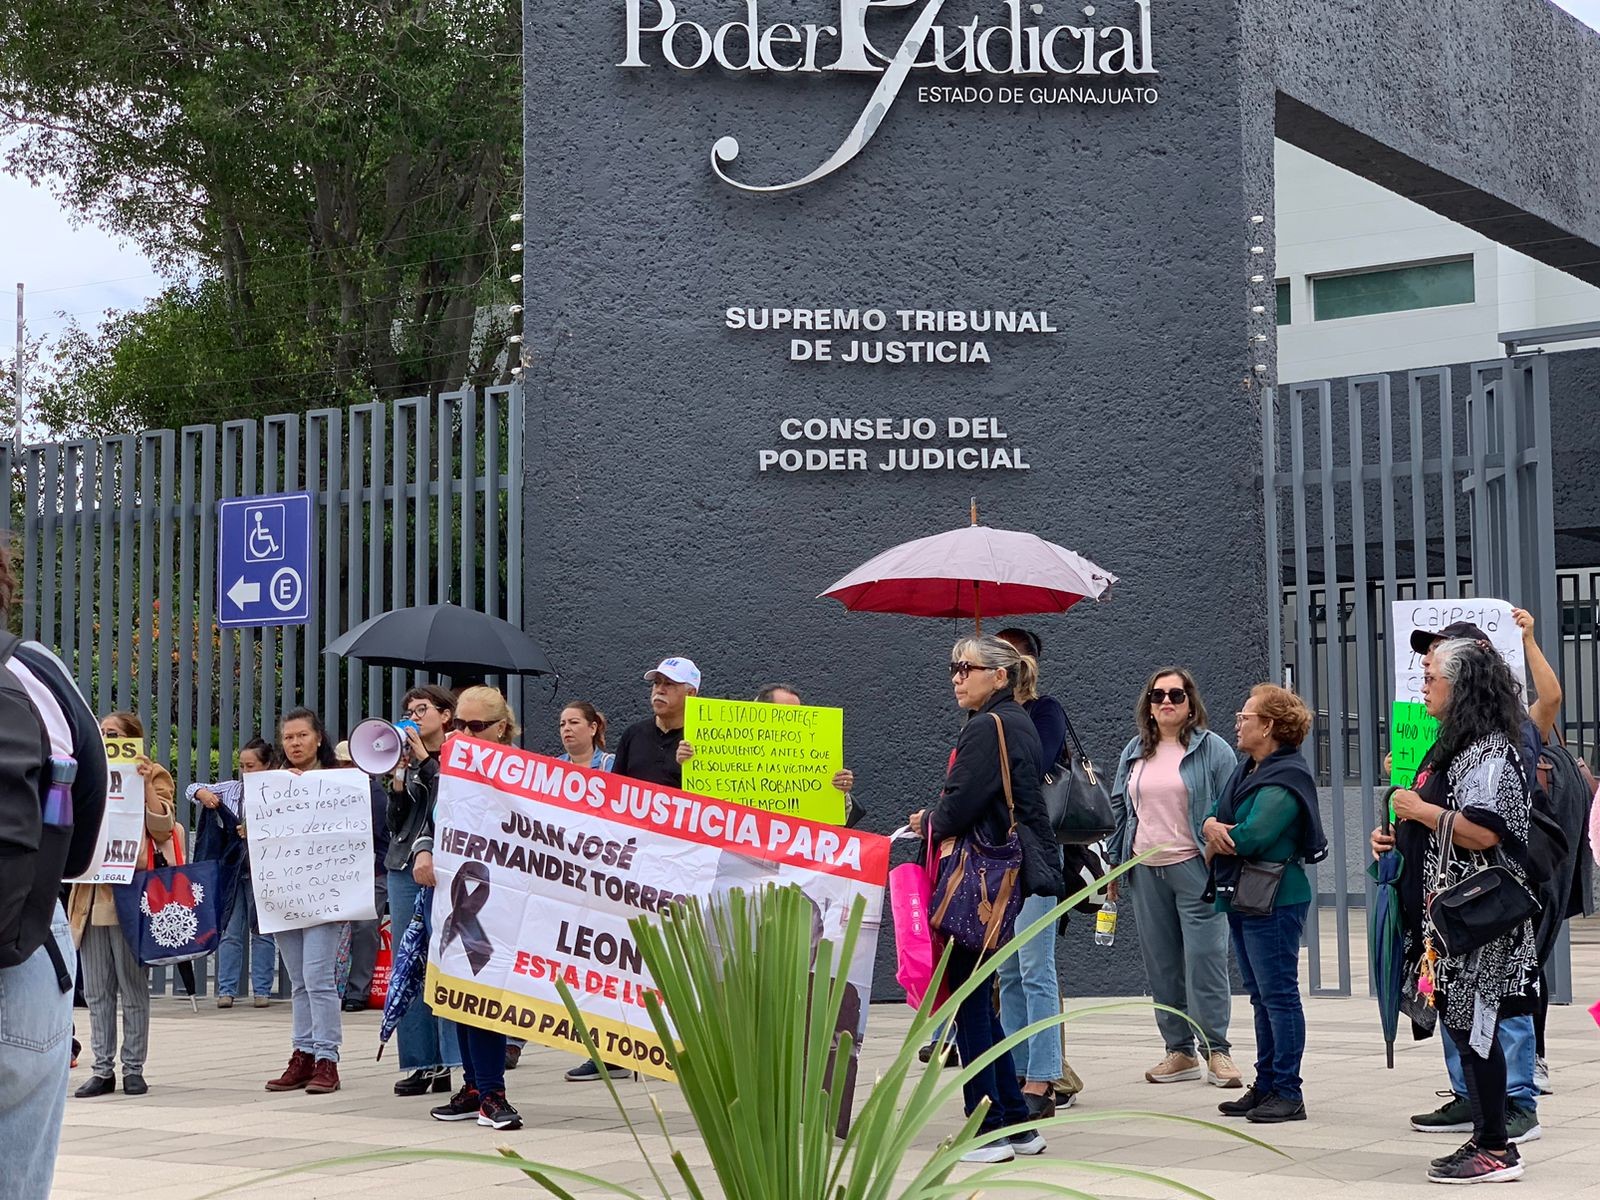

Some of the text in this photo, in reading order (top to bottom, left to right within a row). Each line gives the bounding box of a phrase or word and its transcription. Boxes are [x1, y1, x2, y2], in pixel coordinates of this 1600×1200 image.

[615, 0, 837, 72] Poder
[918, 86, 1159, 105] ESTADO DE GUANAJUATO
[725, 307, 1057, 333] SUPREMO TRIBUNAL
[790, 339, 991, 363] DE JUSTICIA
[780, 417, 1008, 441] CONSEJO DEL
[759, 448, 1031, 472] PODER JUDICIAL
[699, 704, 820, 728] EL ESTADO PROTEGE
[695, 727, 816, 744] ABOGADOS RATEROS Y
[694, 745, 831, 760] FRAUDULENTOS ANTES QUE
[692, 760, 754, 773] RESOLVERLE
[757, 763, 763, 772] A
[765, 763, 781, 774] LAS
[686, 776, 823, 794] NOS ESTÁN ROBANDO
[448, 739, 862, 872] EXIGIMOS JUSTICIA PARA
[307, 840, 367, 856] derechos
[501, 810, 638, 871] JUAN JOSÉ
[441, 827, 588, 892] HERNANDEZ
[103, 873, 127, 882] EGAL
[556, 920, 643, 975] LEON
[513, 950, 580, 990] ESTA
[585, 969, 618, 999] DE
[434, 985, 536, 1029] GURIDAD
[605, 1031, 674, 1071] TODO
